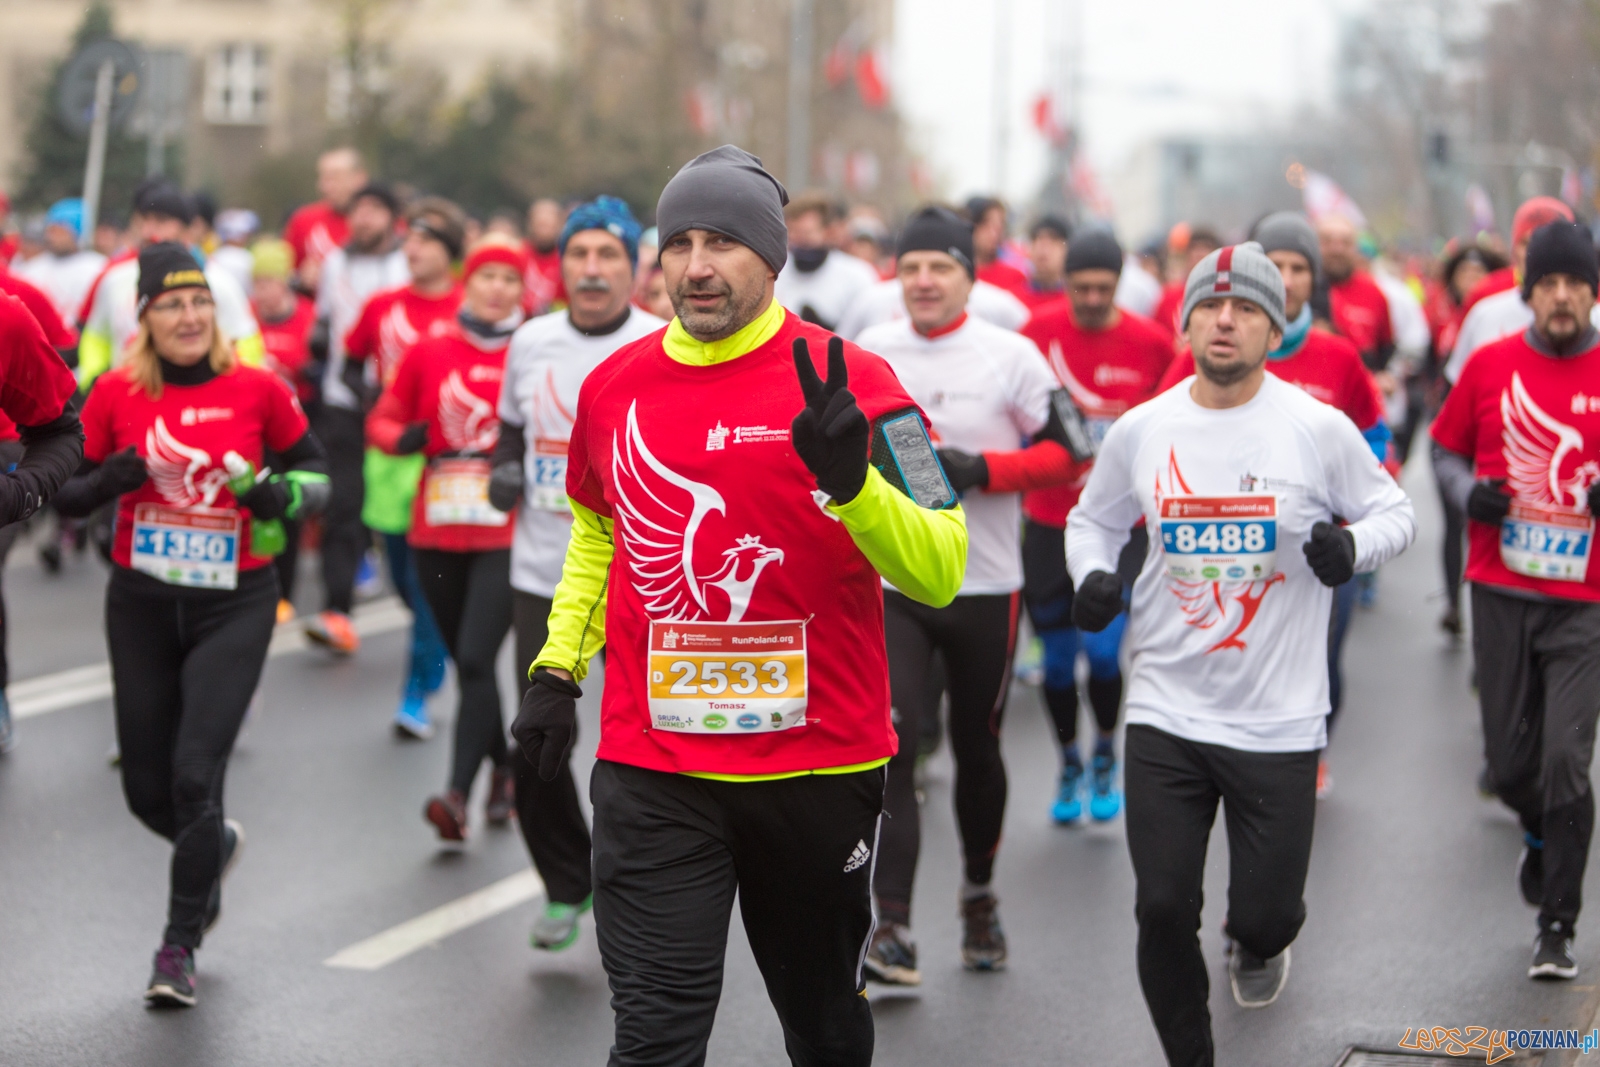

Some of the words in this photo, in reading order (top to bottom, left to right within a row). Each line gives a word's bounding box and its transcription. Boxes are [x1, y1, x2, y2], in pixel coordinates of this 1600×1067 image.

[733, 426, 742, 443] 1
[149, 531, 227, 561] 1350
[1175, 523, 1266, 553] 8488
[1514, 522, 1581, 555] 3977
[732, 635, 794, 645] RunPoland.org
[653, 671, 664, 683] D
[669, 660, 789, 695] 2533
[708, 702, 746, 710] Tomasz
[657, 714, 681, 722] GRUPA
[658, 721, 685, 729] LUXMED
[843, 849, 870, 872] adidas
